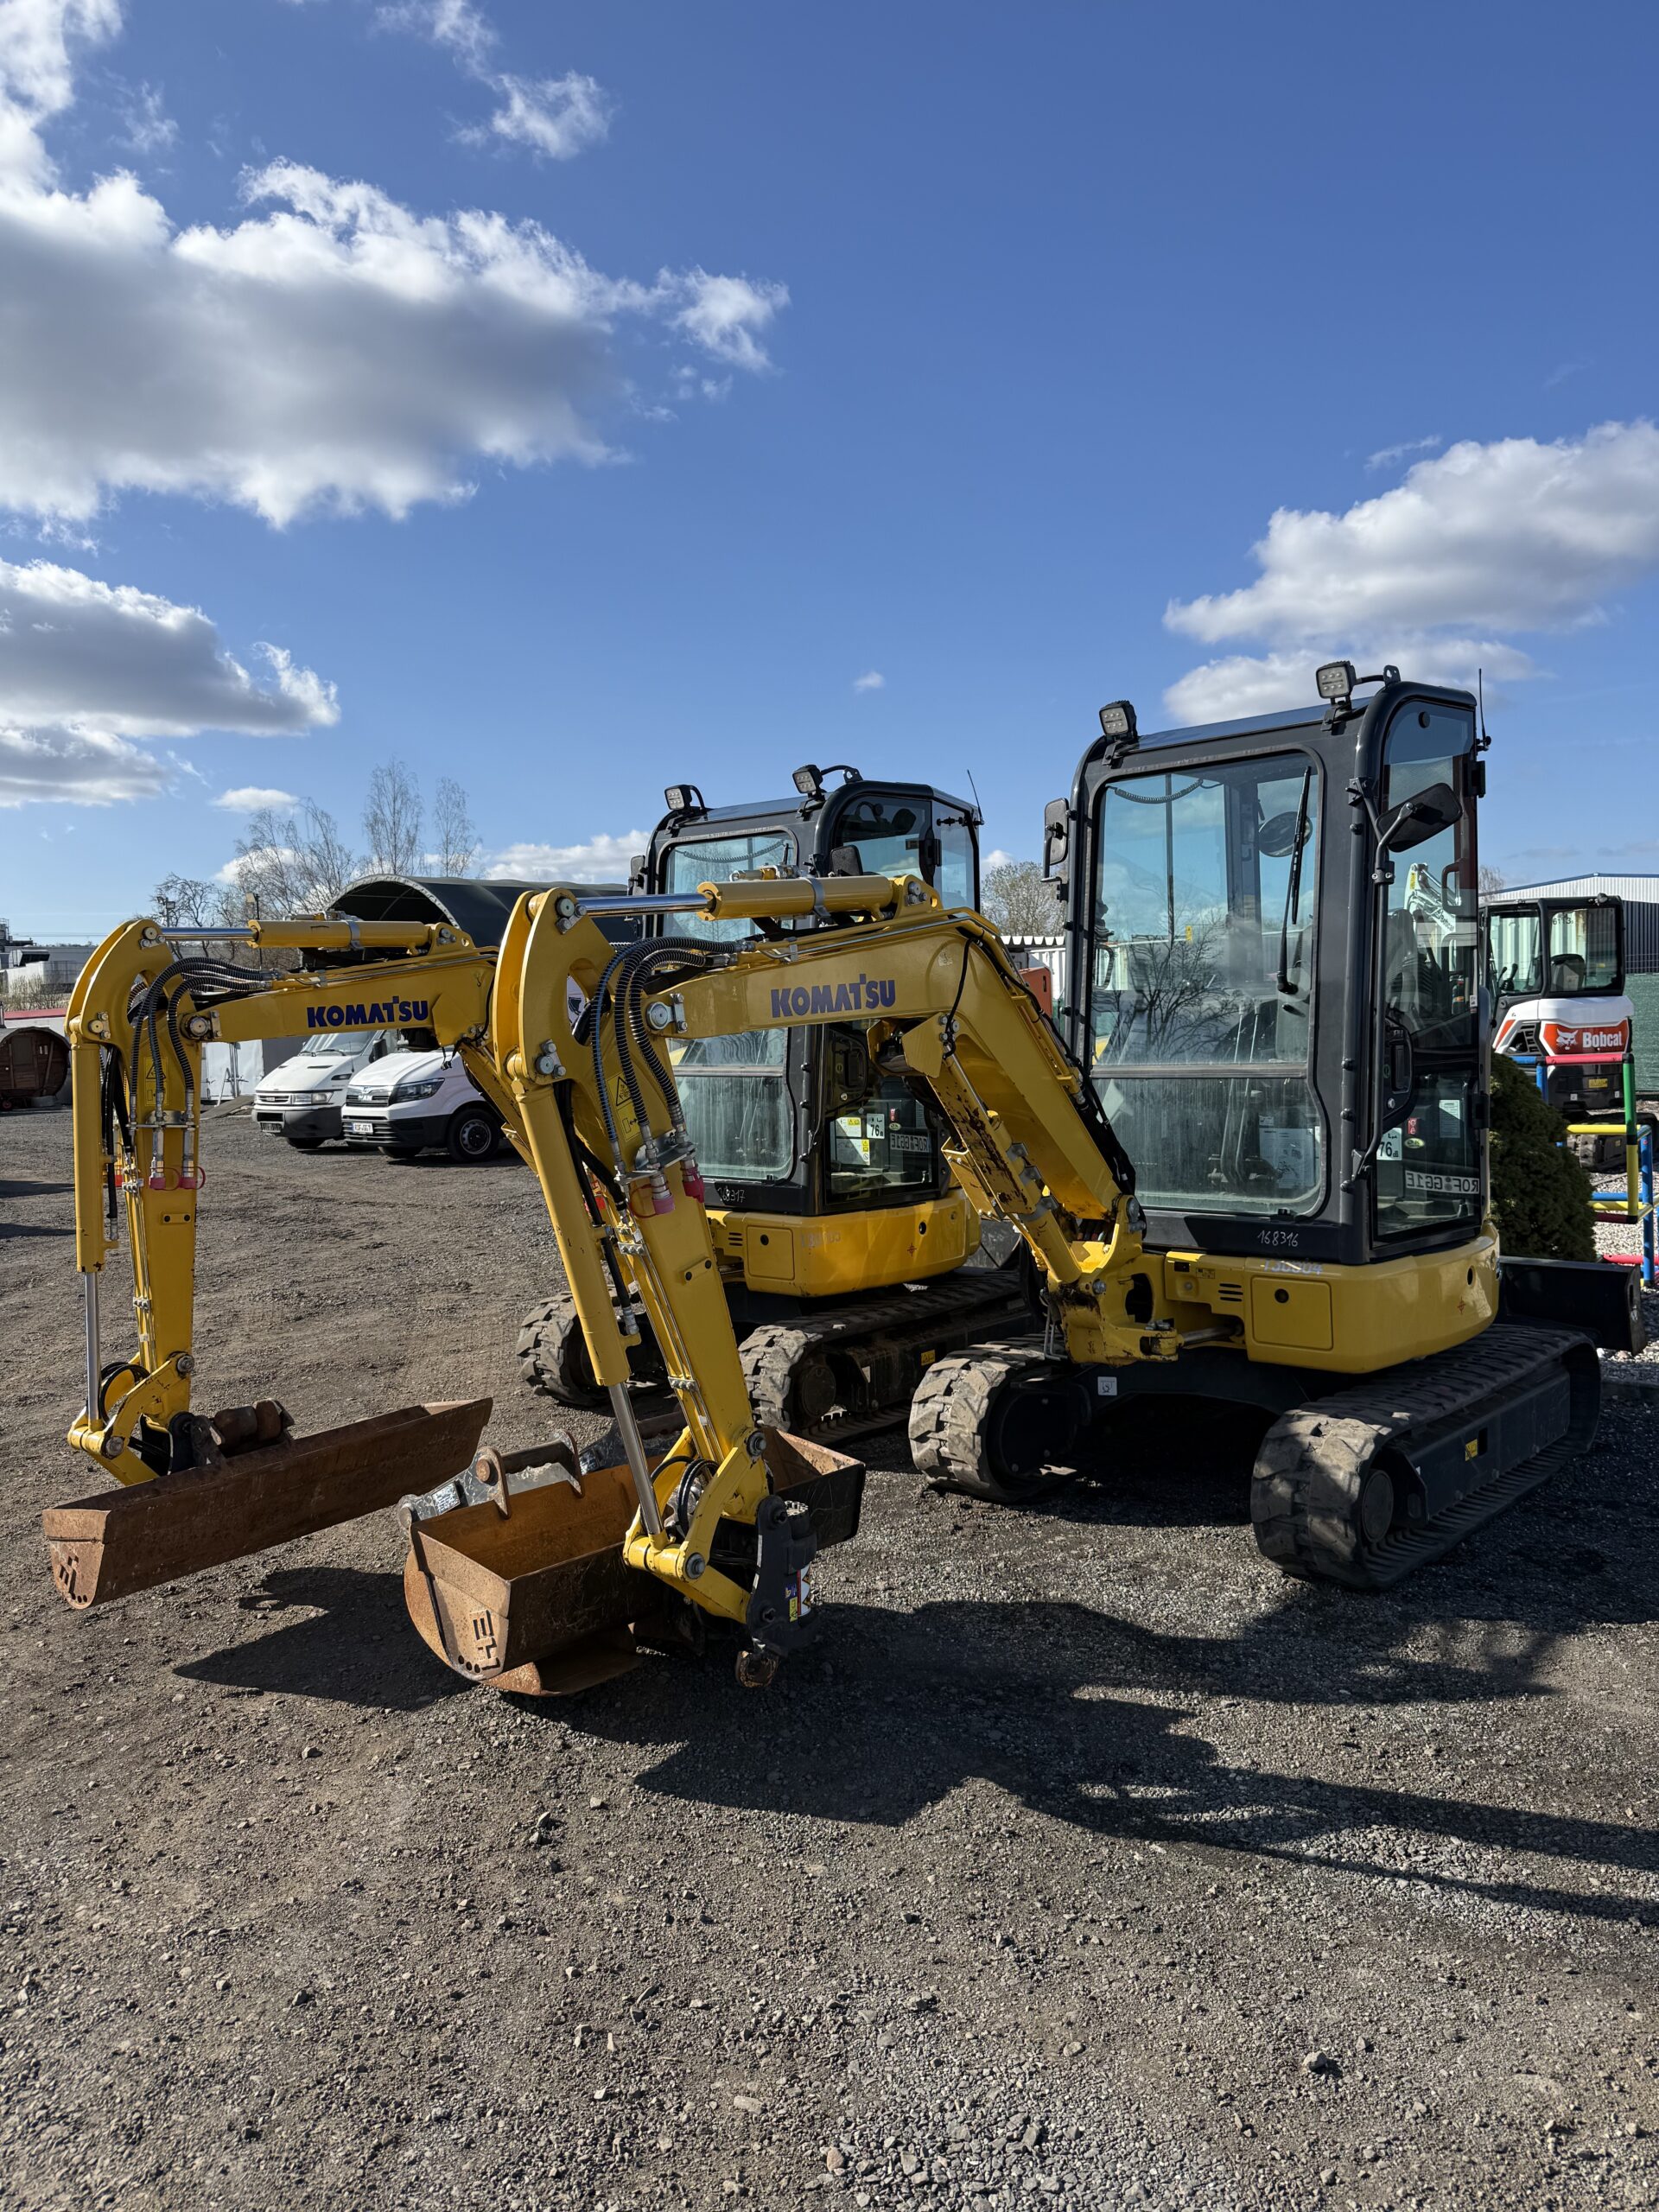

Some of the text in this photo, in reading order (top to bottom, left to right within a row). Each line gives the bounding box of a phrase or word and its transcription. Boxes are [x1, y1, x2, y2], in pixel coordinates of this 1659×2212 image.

[771, 973, 896, 1018] KOMATSU
[306, 995, 429, 1028] KOMATSU
[1582, 1030, 1623, 1048] Bobcat
[870, 1124, 880, 1137] 76
[1380, 1141, 1393, 1157] 76
[1257, 1230, 1299, 1247] 168316
